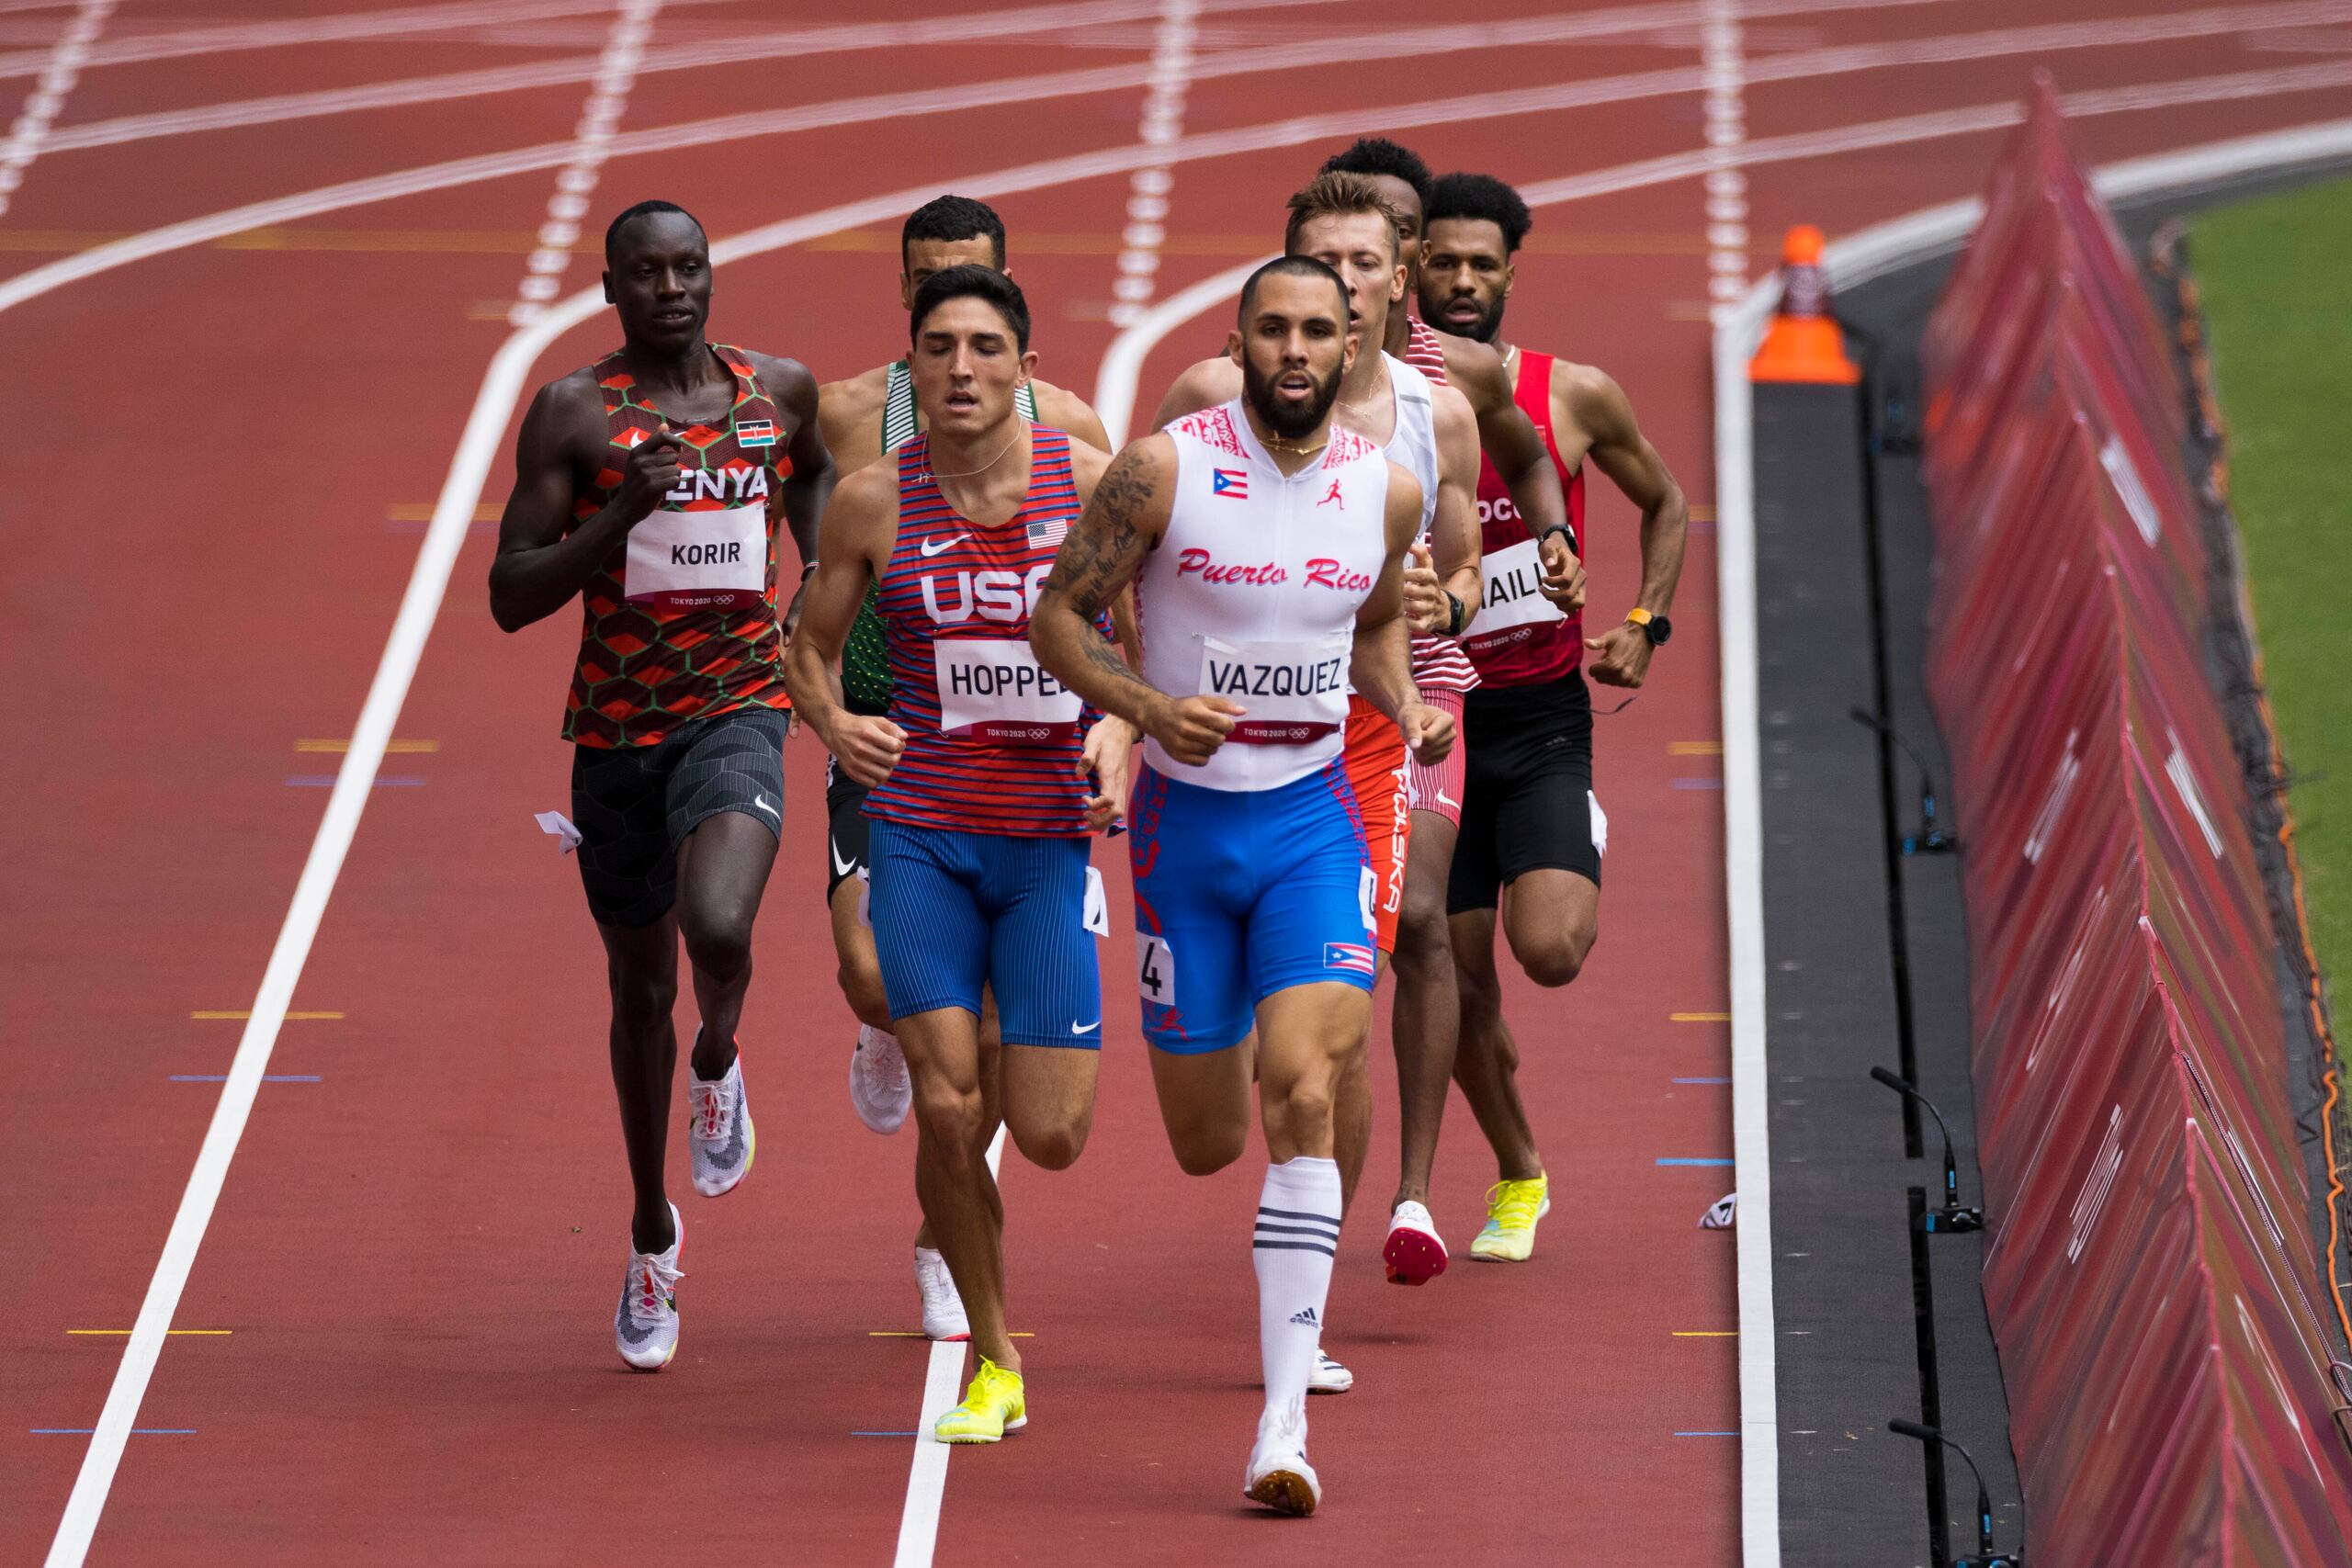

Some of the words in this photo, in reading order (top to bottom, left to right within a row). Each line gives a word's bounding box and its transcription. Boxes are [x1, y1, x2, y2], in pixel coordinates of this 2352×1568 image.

[665, 467, 769, 501] ENYA
[671, 542, 741, 565] KORIR
[1177, 548, 1289, 585] Puerto
[1303, 558, 1371, 592] Rico
[670, 597, 694, 605] TOKYO
[695, 597, 712, 605] 2020
[1480, 562, 1543, 610] AILI
[1470, 640, 1492, 650] TOKYO
[1492, 636, 1510, 646] 2020
[950, 663, 1070, 697] HOPPE
[1209, 658, 1341, 696] VAZQUEZ
[987, 728, 1009, 737] TOKYO
[1244, 728, 1268, 737] TOKYO
[1269, 729, 1287, 738] 2020
[1383, 768, 1408, 914] POLSKA
[1141, 942, 1162, 997] 4
